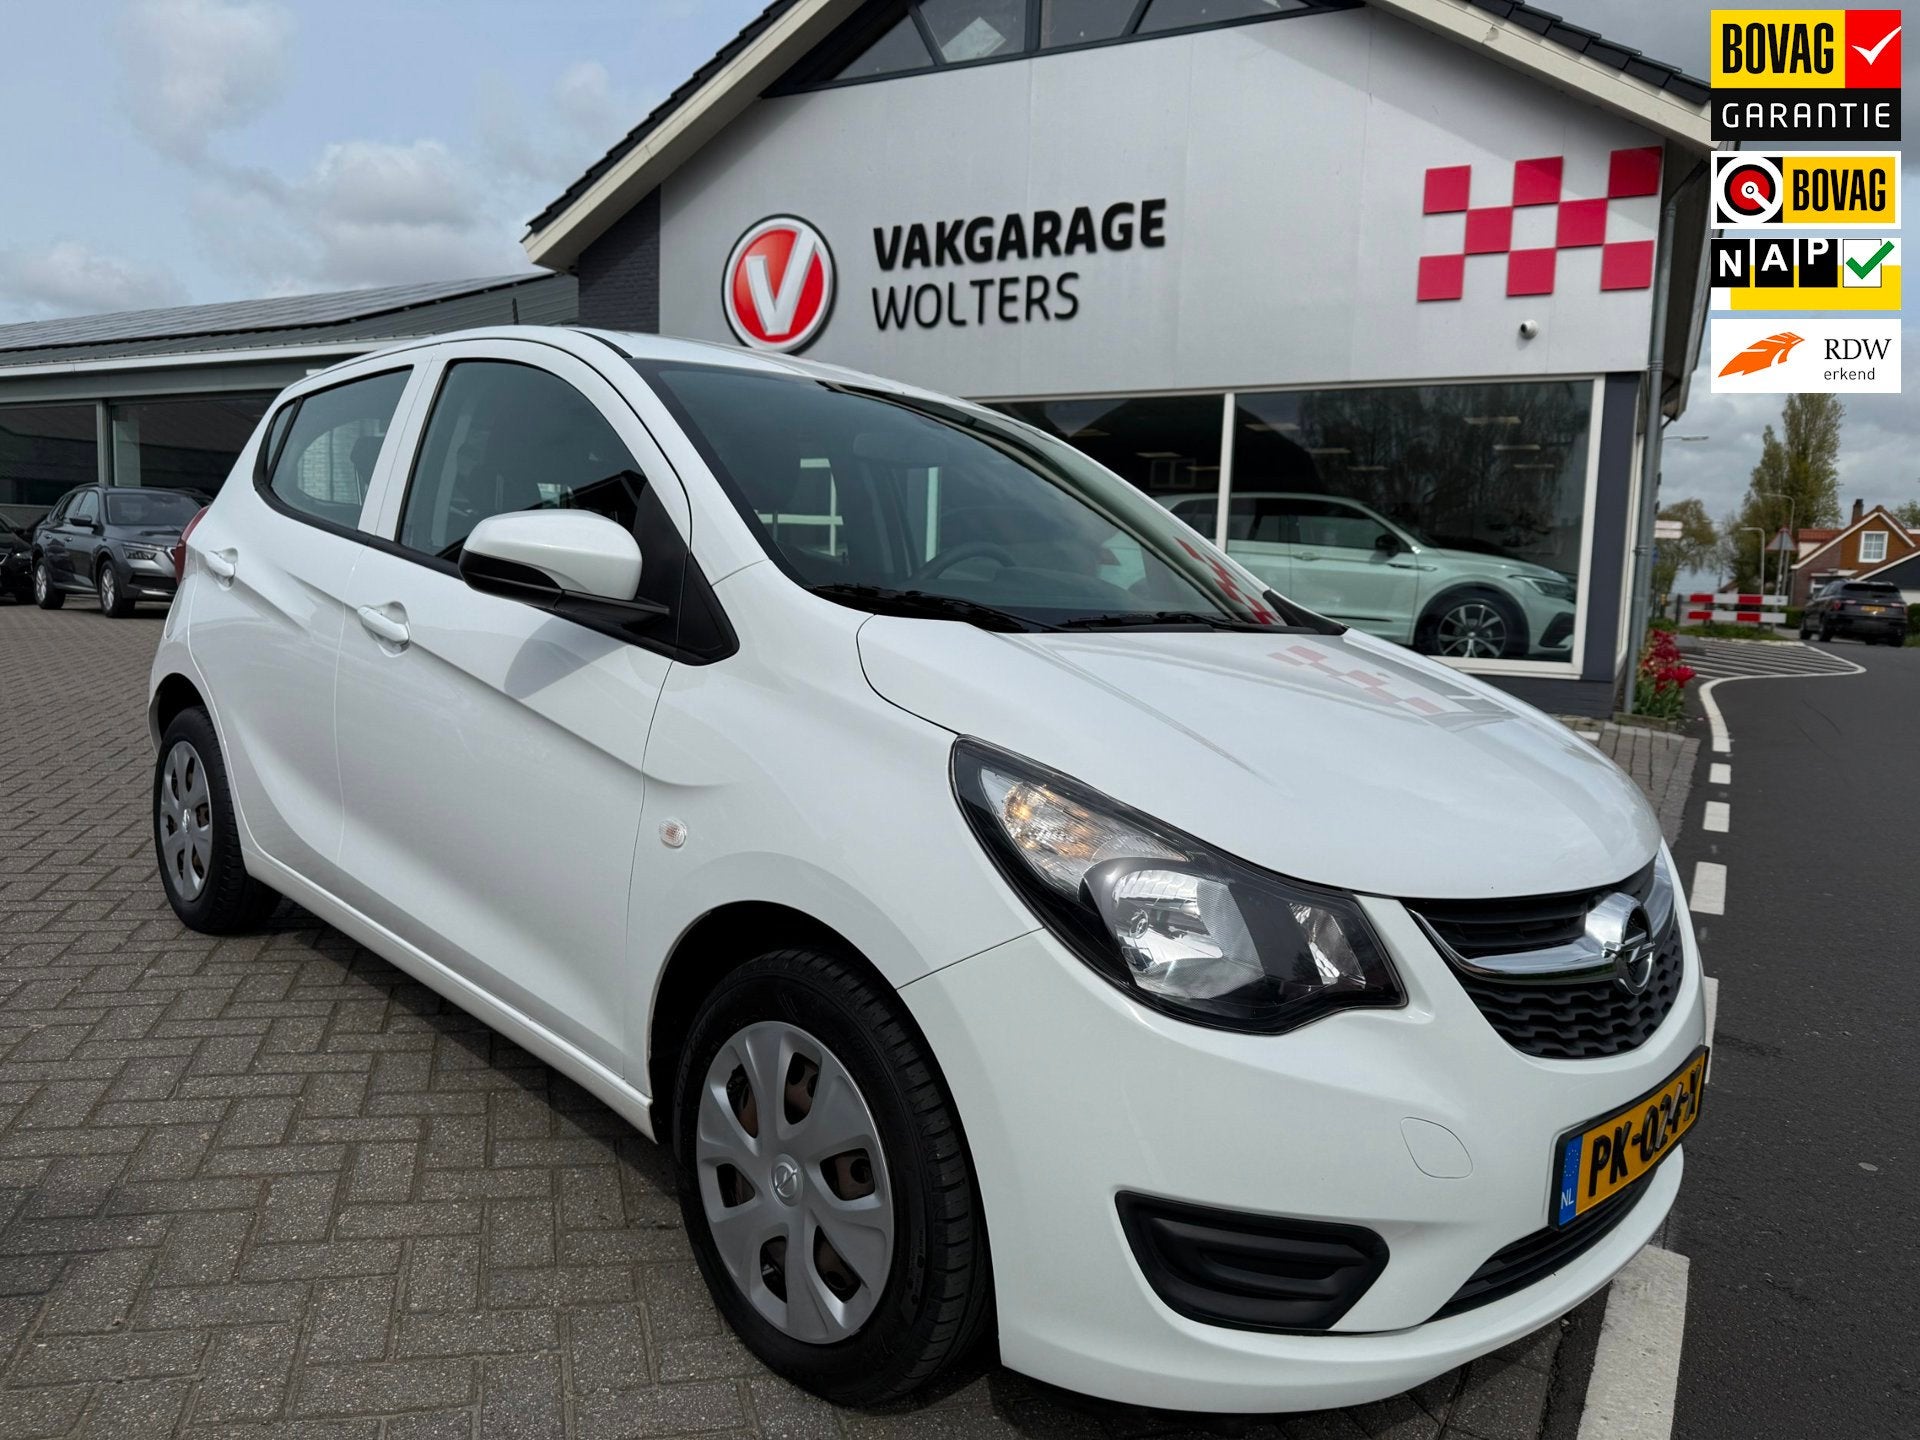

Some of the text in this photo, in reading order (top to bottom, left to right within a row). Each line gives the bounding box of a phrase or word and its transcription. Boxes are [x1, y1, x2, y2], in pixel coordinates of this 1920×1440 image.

[873, 198, 1166, 271] VAKGARAGE
[872, 272, 1080, 331] WOLTERS
[1560, 1188, 1575, 1210] NL
